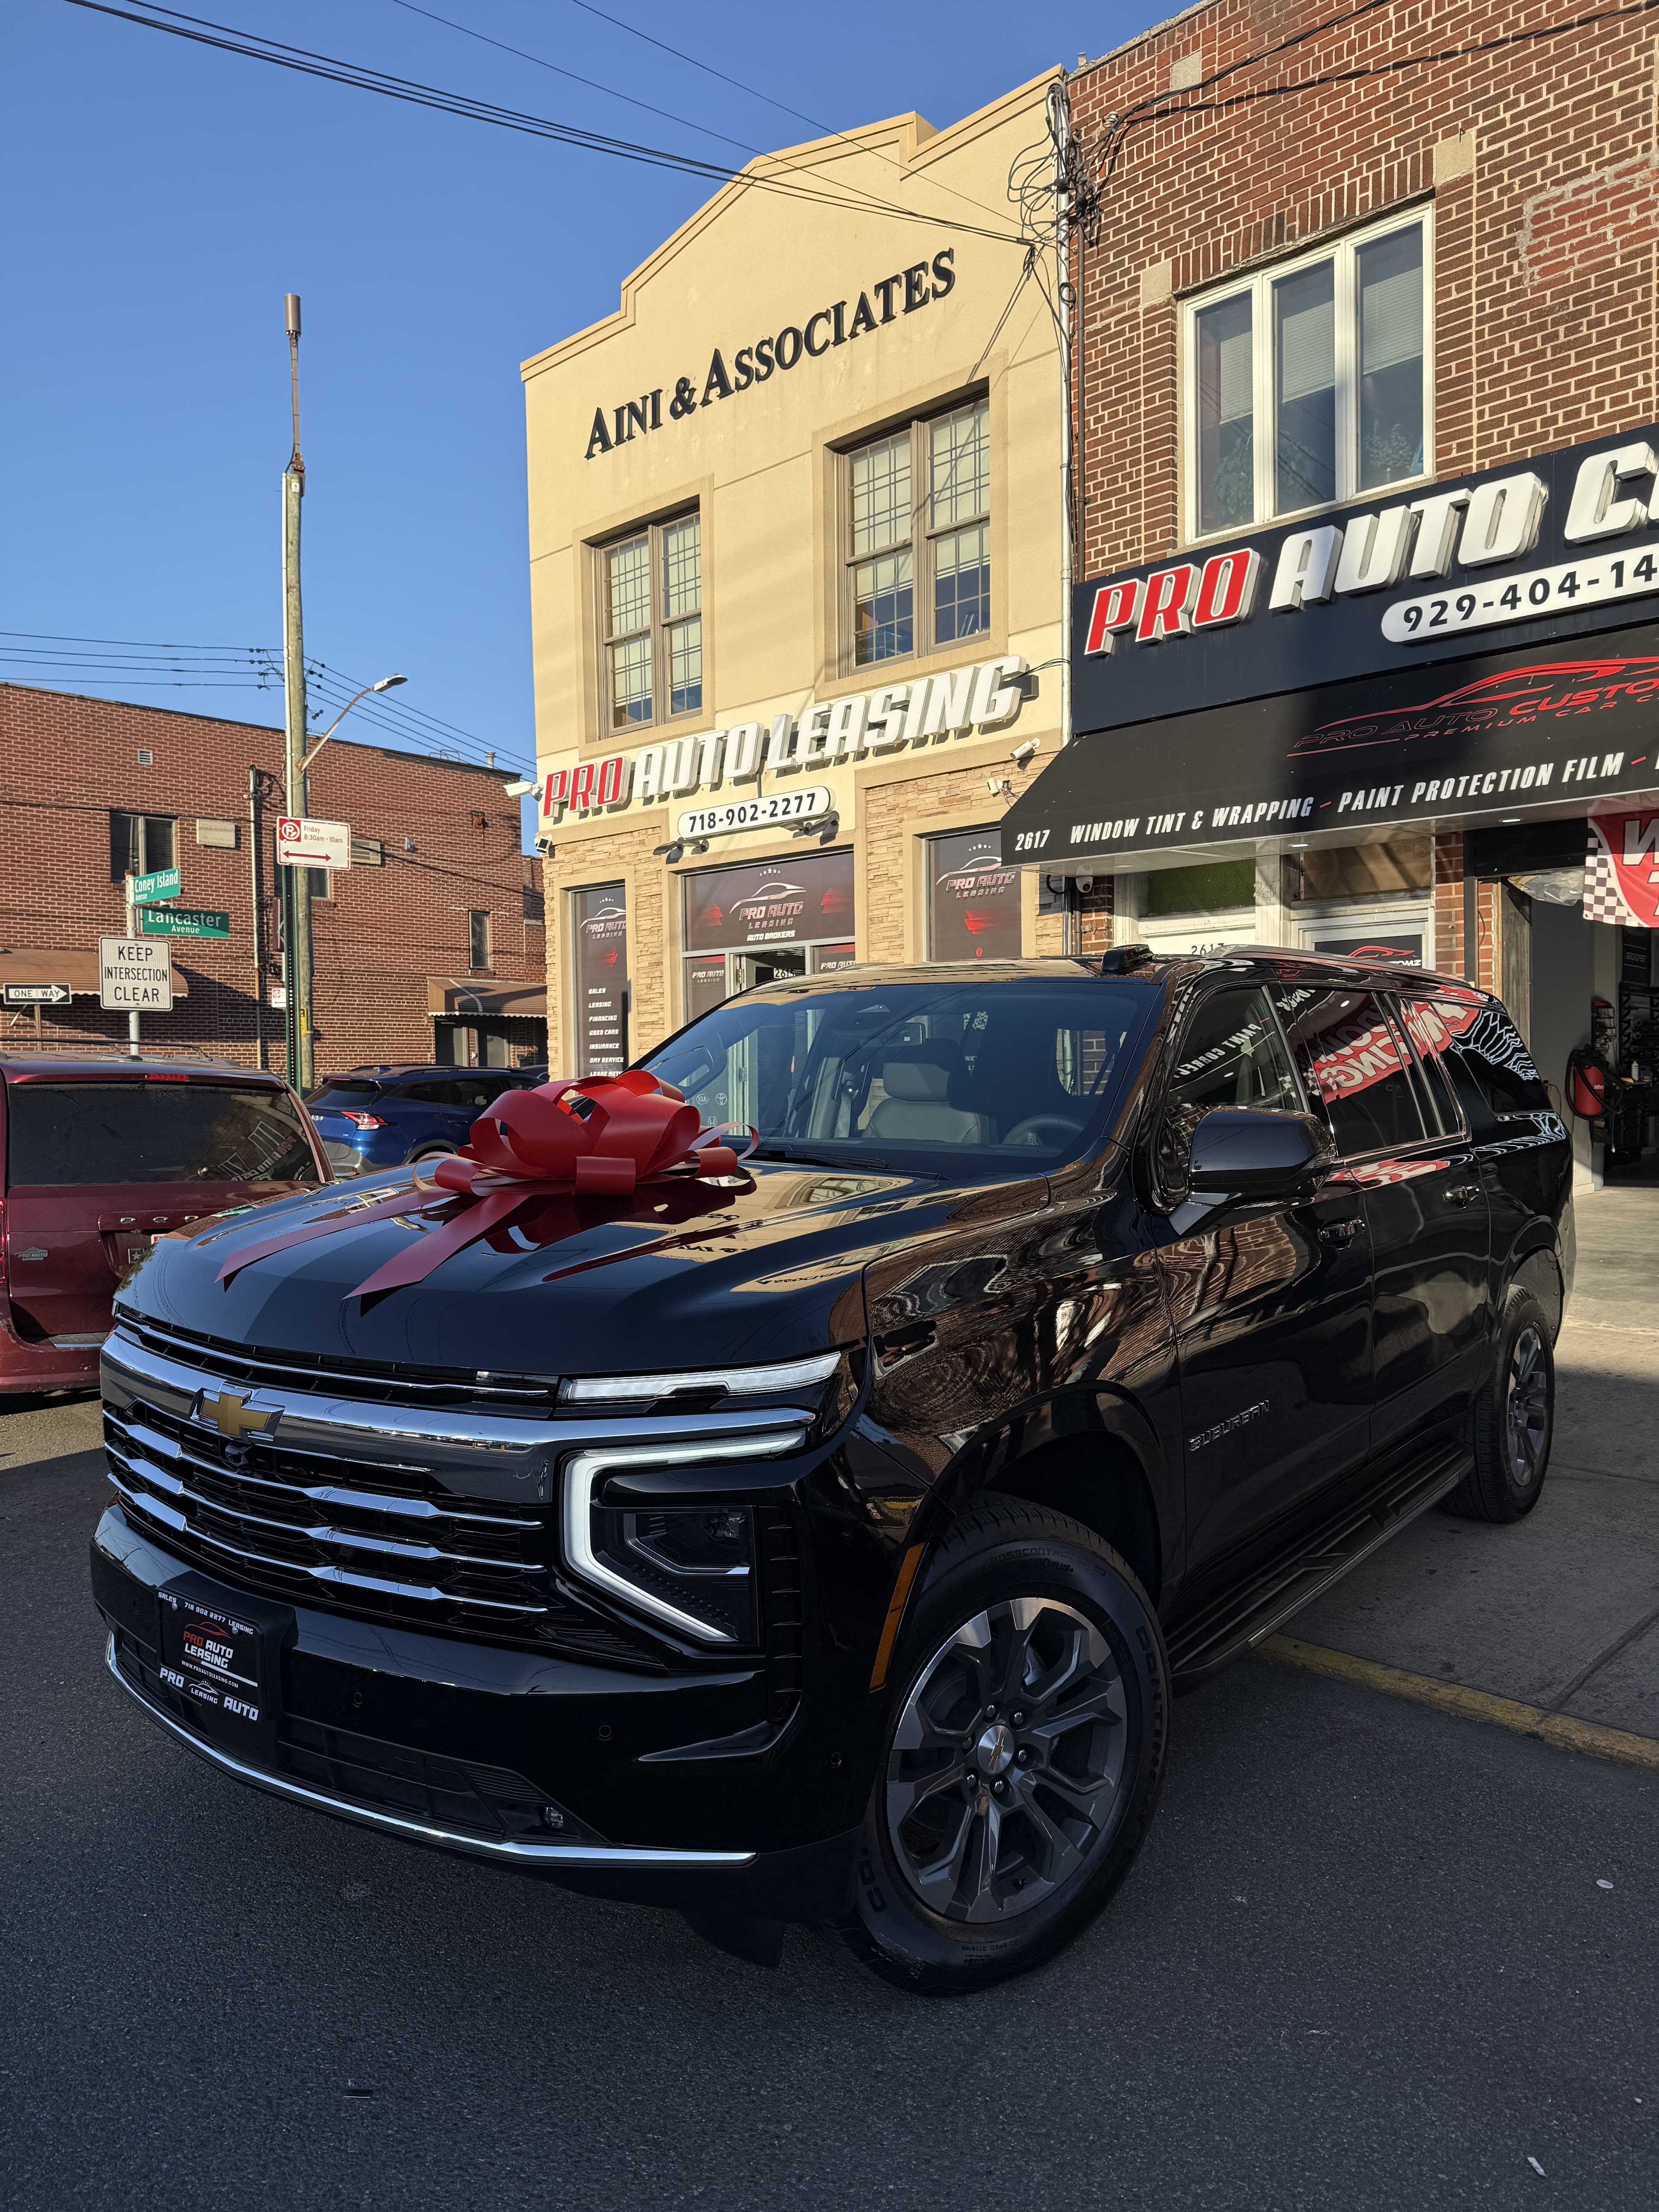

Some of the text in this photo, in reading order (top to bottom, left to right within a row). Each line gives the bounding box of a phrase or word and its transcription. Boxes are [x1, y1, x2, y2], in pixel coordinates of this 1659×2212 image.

[584, 247, 956, 460] AINI & ASSOCIATES
[1084, 442, 1659, 657] PRO AUTO C
[1403, 554, 1658, 632] 929-404-14
[1294, 726, 1378, 747] PRO
[1382, 708, 1498, 735] AUTO
[1404, 715, 1536, 741] PREMIUM
[1555, 702, 1618, 717] CAR
[543, 655, 1027, 818] PRO AUTO LEASING
[689, 792, 817, 833] 718-902-2277
[1015, 829, 1051, 851] 2617
[1070, 818, 1140, 844] WINDOW
[1146, 812, 1186, 836] TINT
[1191, 810, 1204, 830] &
[1211, 796, 1314, 827] WRAPPING
[1338, 785, 1404, 813] PAINT
[1411, 763, 1554, 804] PROTECTION
[1561, 752, 1624, 783] FILM
[304, 826, 321, 834] Friday
[134, 869, 178, 893] Coney Island
[946, 872, 1016, 891] PRO AUTO
[956, 887, 1005, 899] LEASING
[148, 909, 221, 927] Lancaster
[739, 901, 804, 921] PRO AUTO
[748, 918, 794, 929] LEASING
[171, 925, 200, 934] Avenue
[586, 923, 604, 933] PRO
[747, 930, 796, 941] AUTO BROKERS
[118, 946, 153, 961] KEEP
[104, 966, 168, 982] INTERSECTION
[114, 987, 159, 1002] CLEAR
[1189, 1400, 1269, 1451] SUBURBAN
[158, 1592, 254, 1635] SALES 718 902 2277 LEASING
[183, 1631, 204, 1647] PRO
[205, 1640, 234, 1659] AUTO
[184, 1643, 229, 1669] LEASING
[181, 1660, 238, 1688] WWW.PROAUTOLEASING.COM
[159, 1667, 259, 1721] PRO LEASING AUTO
